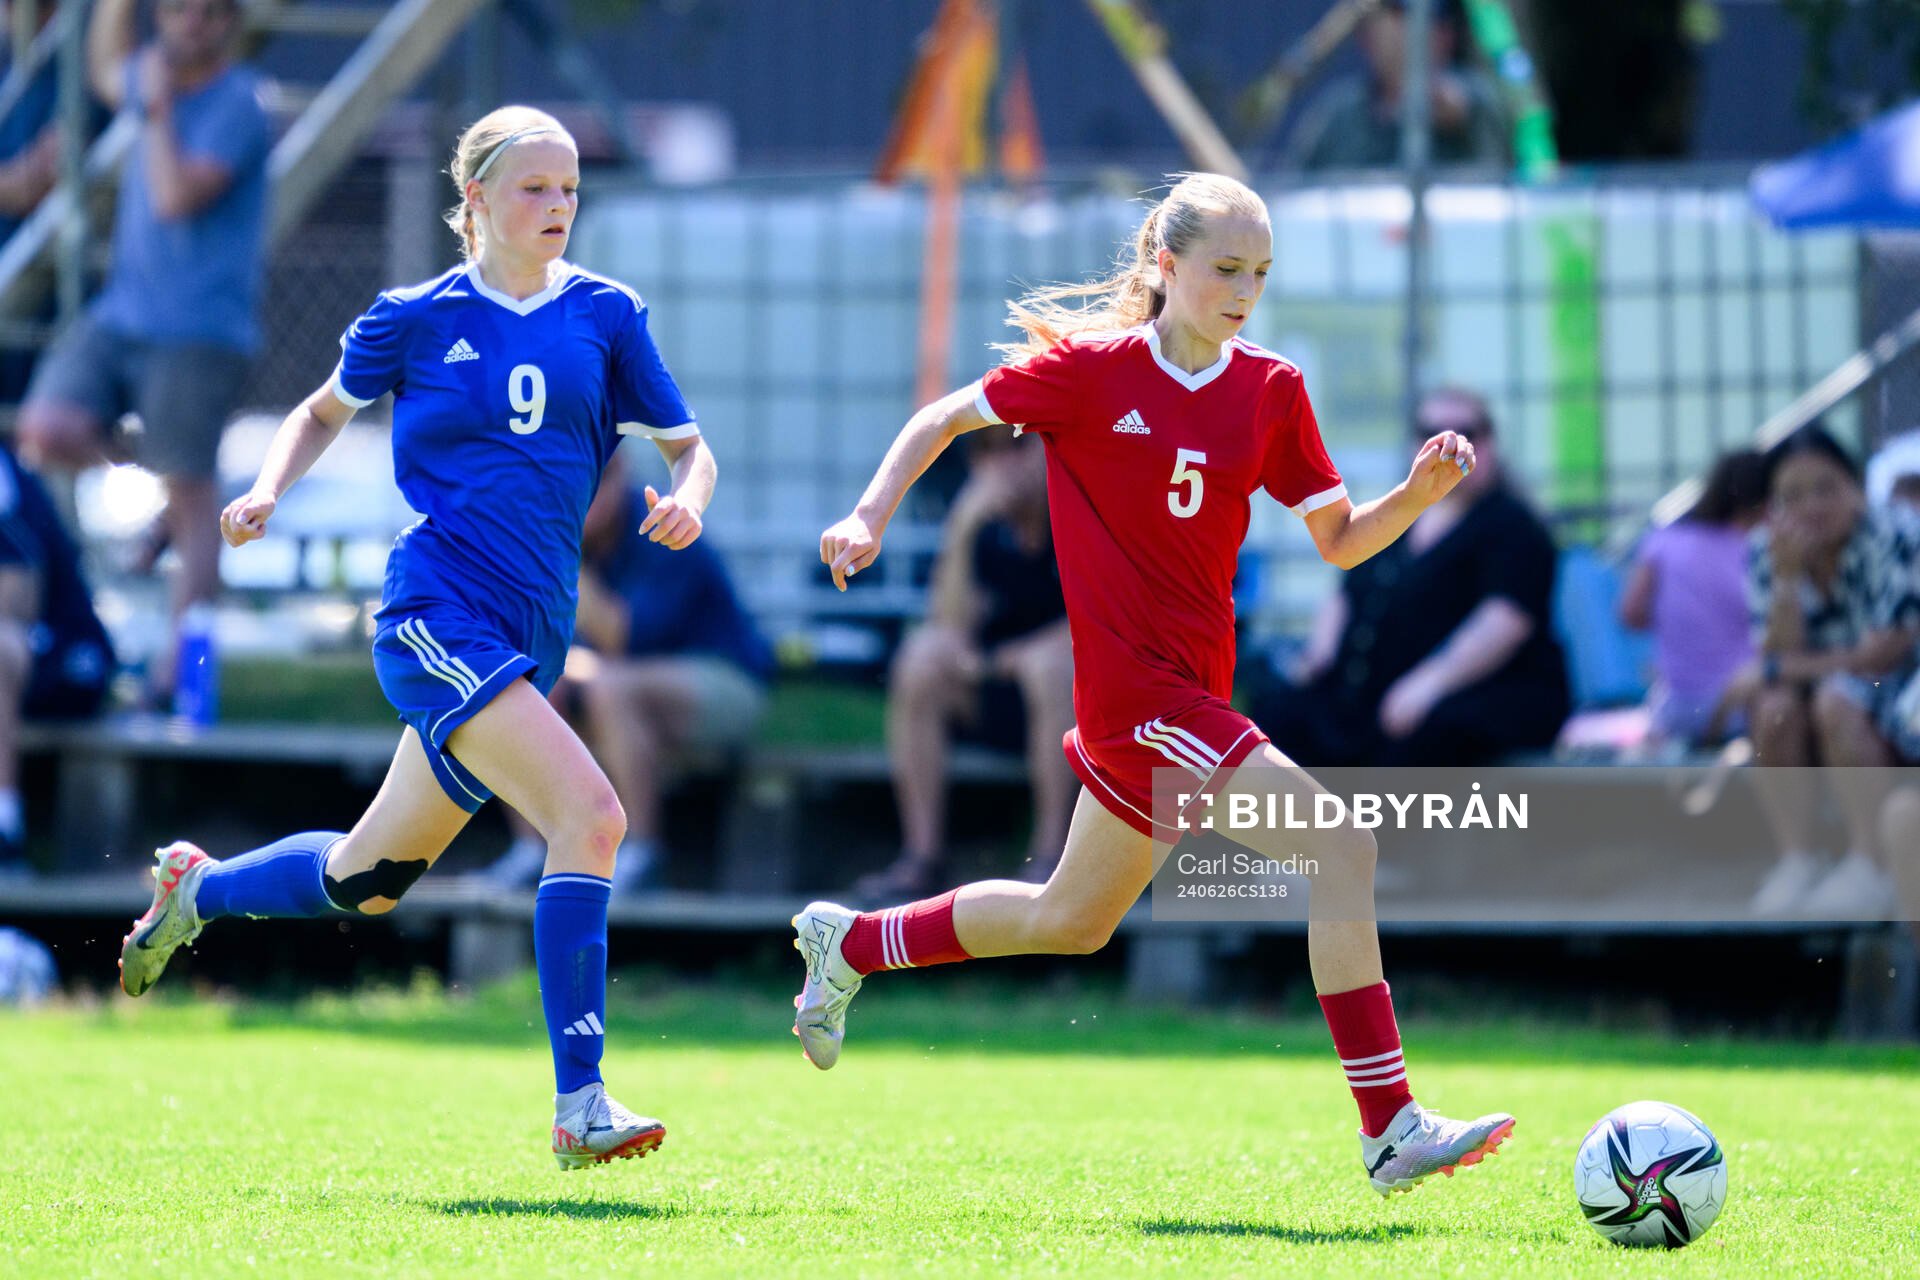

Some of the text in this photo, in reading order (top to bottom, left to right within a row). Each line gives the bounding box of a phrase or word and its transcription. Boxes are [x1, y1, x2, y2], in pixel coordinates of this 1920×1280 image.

[443, 352, 480, 364] adidas
[508, 364, 546, 435] 9
[1112, 424, 1151, 435] adidas
[1167, 448, 1206, 518] 5
